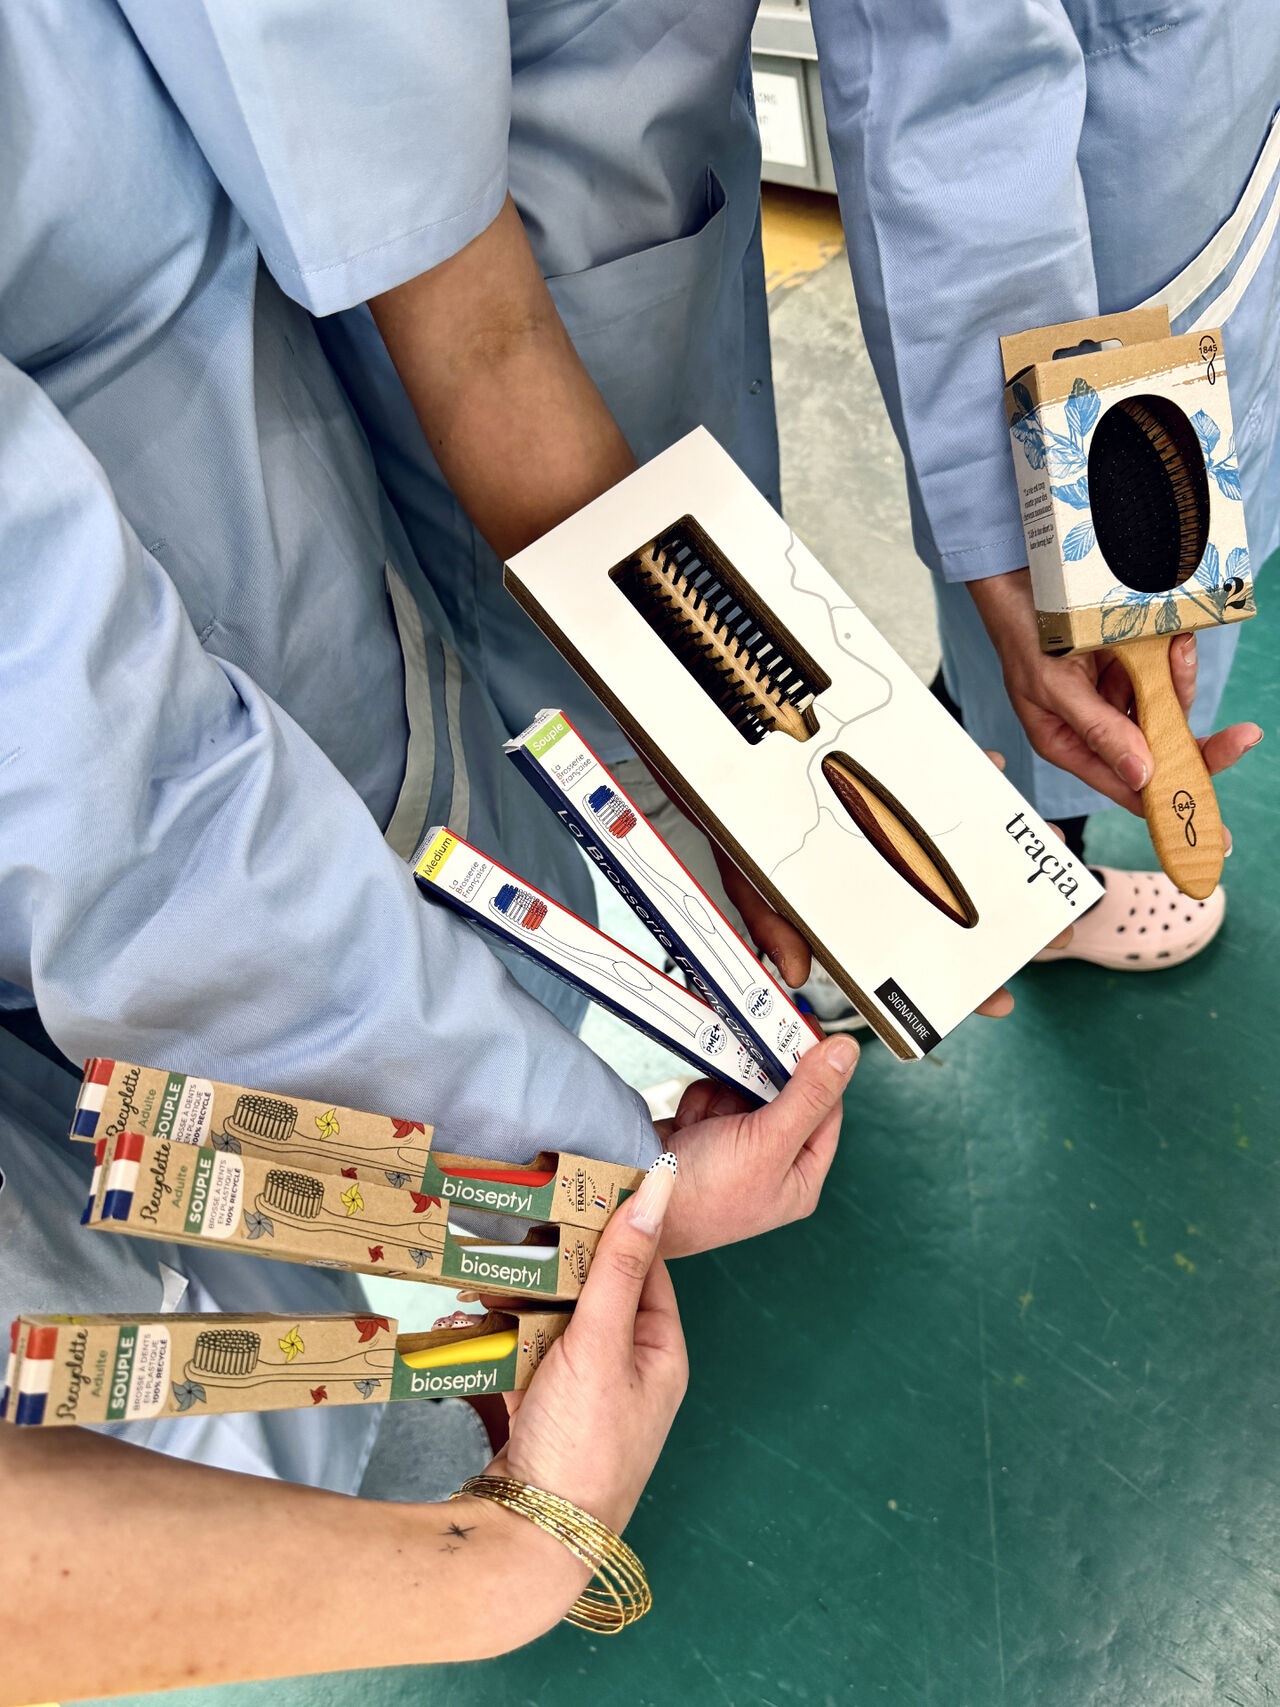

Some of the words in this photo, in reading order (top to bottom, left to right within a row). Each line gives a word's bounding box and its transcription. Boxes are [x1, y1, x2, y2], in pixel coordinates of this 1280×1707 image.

[1199, 344, 1217, 354] 1845
[532, 723, 565, 752] Souple
[551, 764, 561, 775] La
[556, 753, 585, 781] Brosserie
[561, 758, 592, 787] Française
[1172, 800, 1196, 812] 1845
[423, 837, 452, 877] Medium
[449, 879, 459, 890] La
[455, 861, 480, 895] Brosserie
[462, 863, 488, 899] Française
[557, 810, 584, 838] La
[586, 845, 672, 949] Brosserie
[675, 955, 764, 1062] Française
[887, 991, 931, 1041] SIGNATURE
[743, 1057, 754, 1079] FRAN
[138, 1089, 157, 1128] Adulte
[185, 1084, 197, 1109] DENTS
[187, 1091, 203, 1131] PLASTIQUE
[140, 1142, 173, 1224] Recyclette
[172, 1165, 188, 1209] Adulte
[189, 1158, 212, 1224] SOUPLE
[220, 1168, 233, 1212] PLASTIQUE
[441, 1178, 533, 1213] bioseptyl
[225, 1204, 235, 1227] 100%
[461, 1253, 541, 1289] bioseptyl
[56, 1328, 91, 1421] Recyclette
[91, 1350, 108, 1398] Adulte
[112, 1337, 134, 1409] SOUPLE
[410, 1368, 498, 1393] bioseptyl
